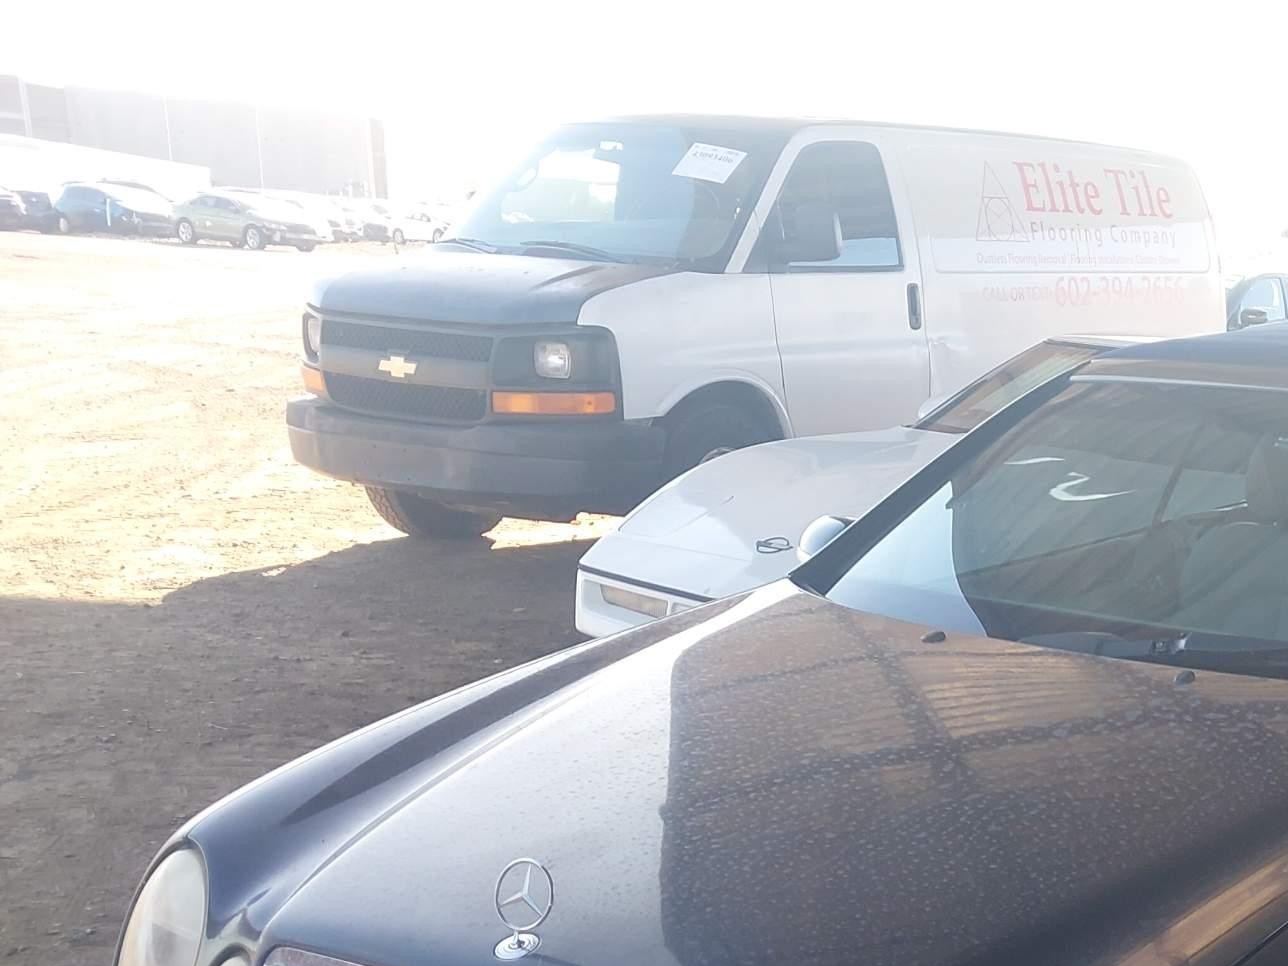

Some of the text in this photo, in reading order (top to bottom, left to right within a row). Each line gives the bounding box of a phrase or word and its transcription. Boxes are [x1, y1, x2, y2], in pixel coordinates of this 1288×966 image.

[1012, 160, 1174, 219] Elite Tile
[1030, 220, 1176, 248] Flooring Company
